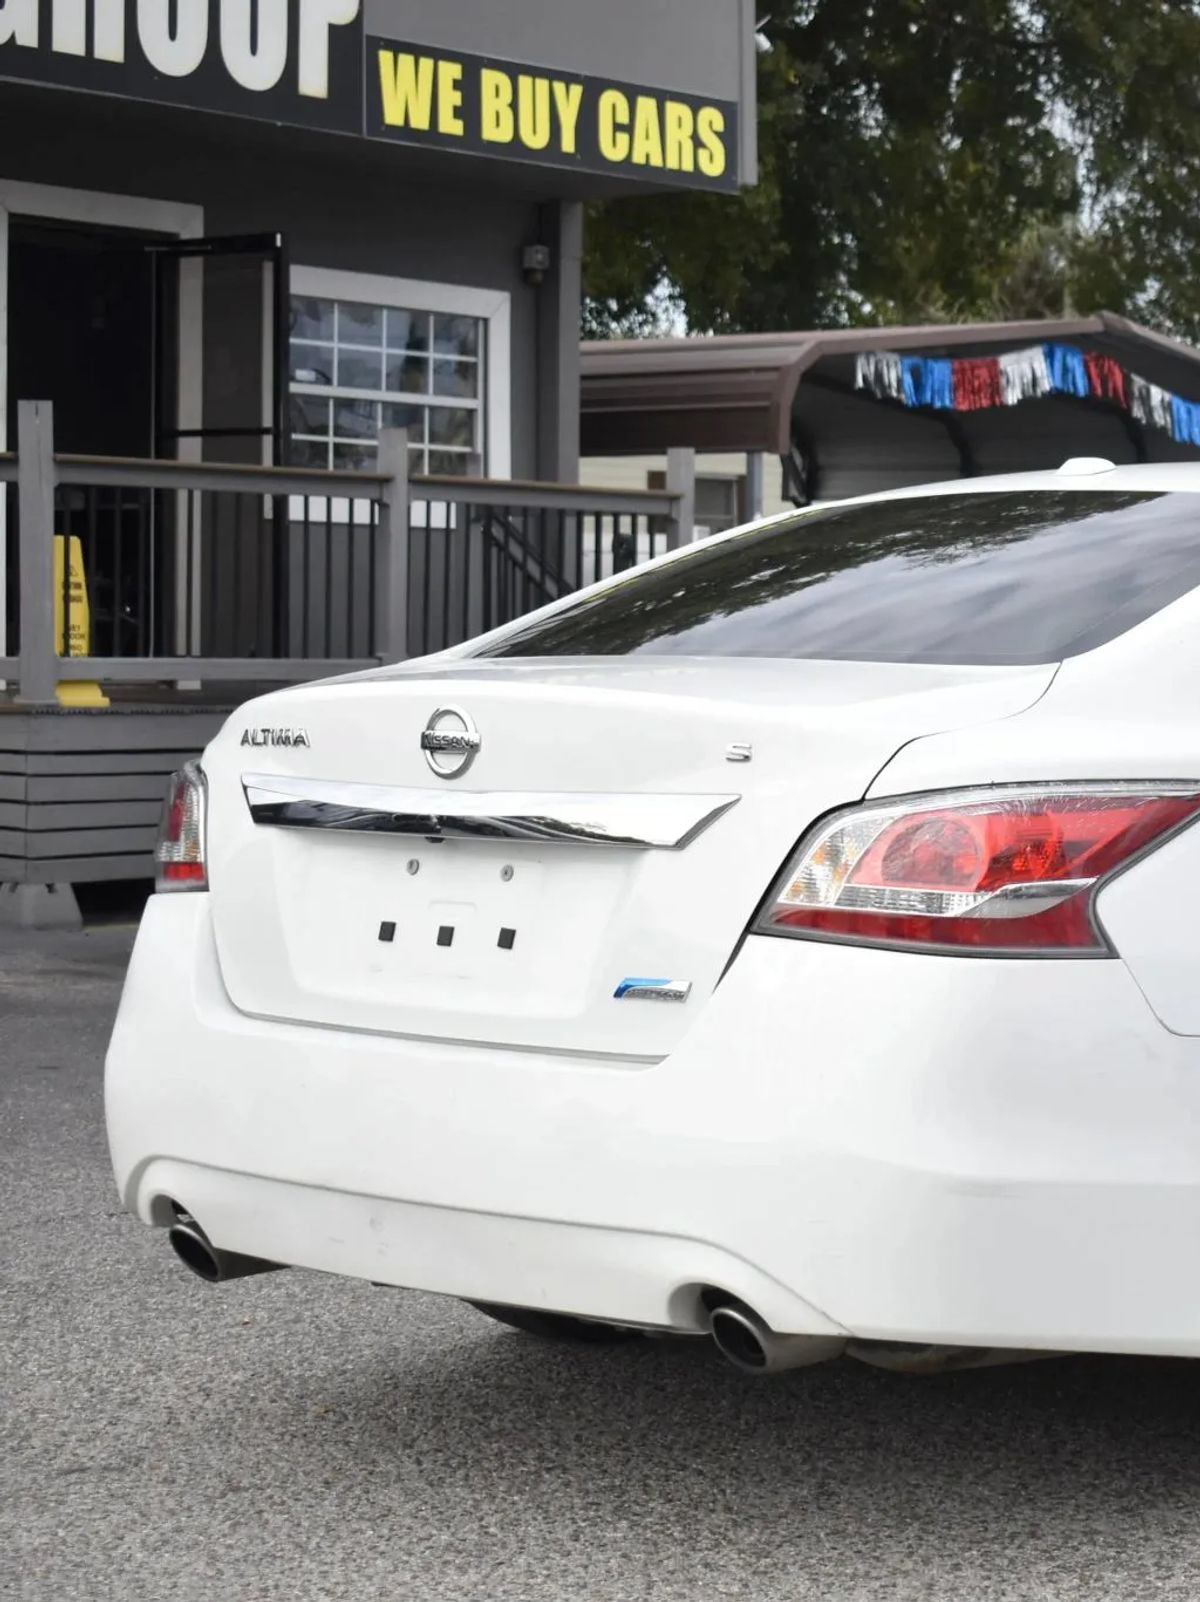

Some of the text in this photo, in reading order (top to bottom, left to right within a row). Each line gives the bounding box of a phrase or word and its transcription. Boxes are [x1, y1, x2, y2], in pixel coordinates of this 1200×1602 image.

[378, 49, 726, 177] WE BUY CARS
[240, 728, 310, 748] ALTIMA
[423, 732, 471, 750] NISSAN
[726, 743, 752, 763] S
